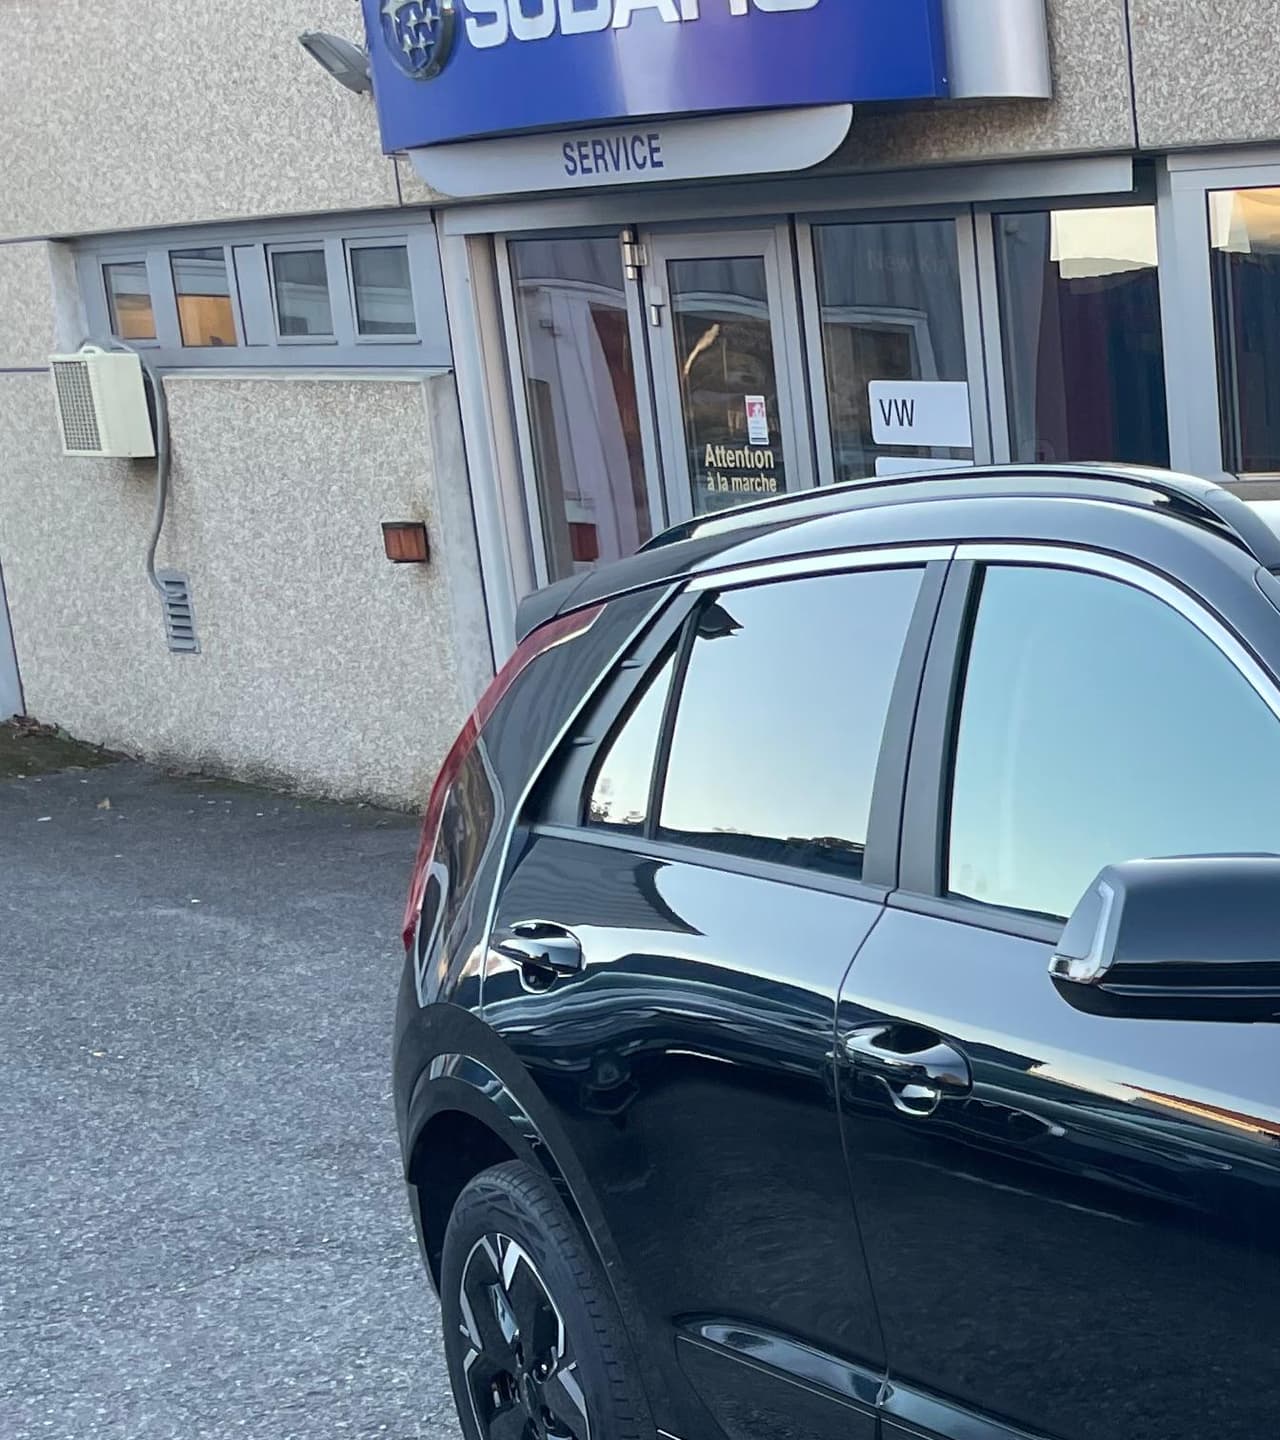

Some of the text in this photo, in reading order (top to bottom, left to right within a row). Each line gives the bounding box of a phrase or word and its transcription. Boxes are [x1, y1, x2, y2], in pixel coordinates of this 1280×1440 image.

[562, 134, 664, 177] SERVICE
[879, 399, 914, 427] VW
[705, 443, 774, 469] Attention
[706, 473, 777, 492] à la marche
